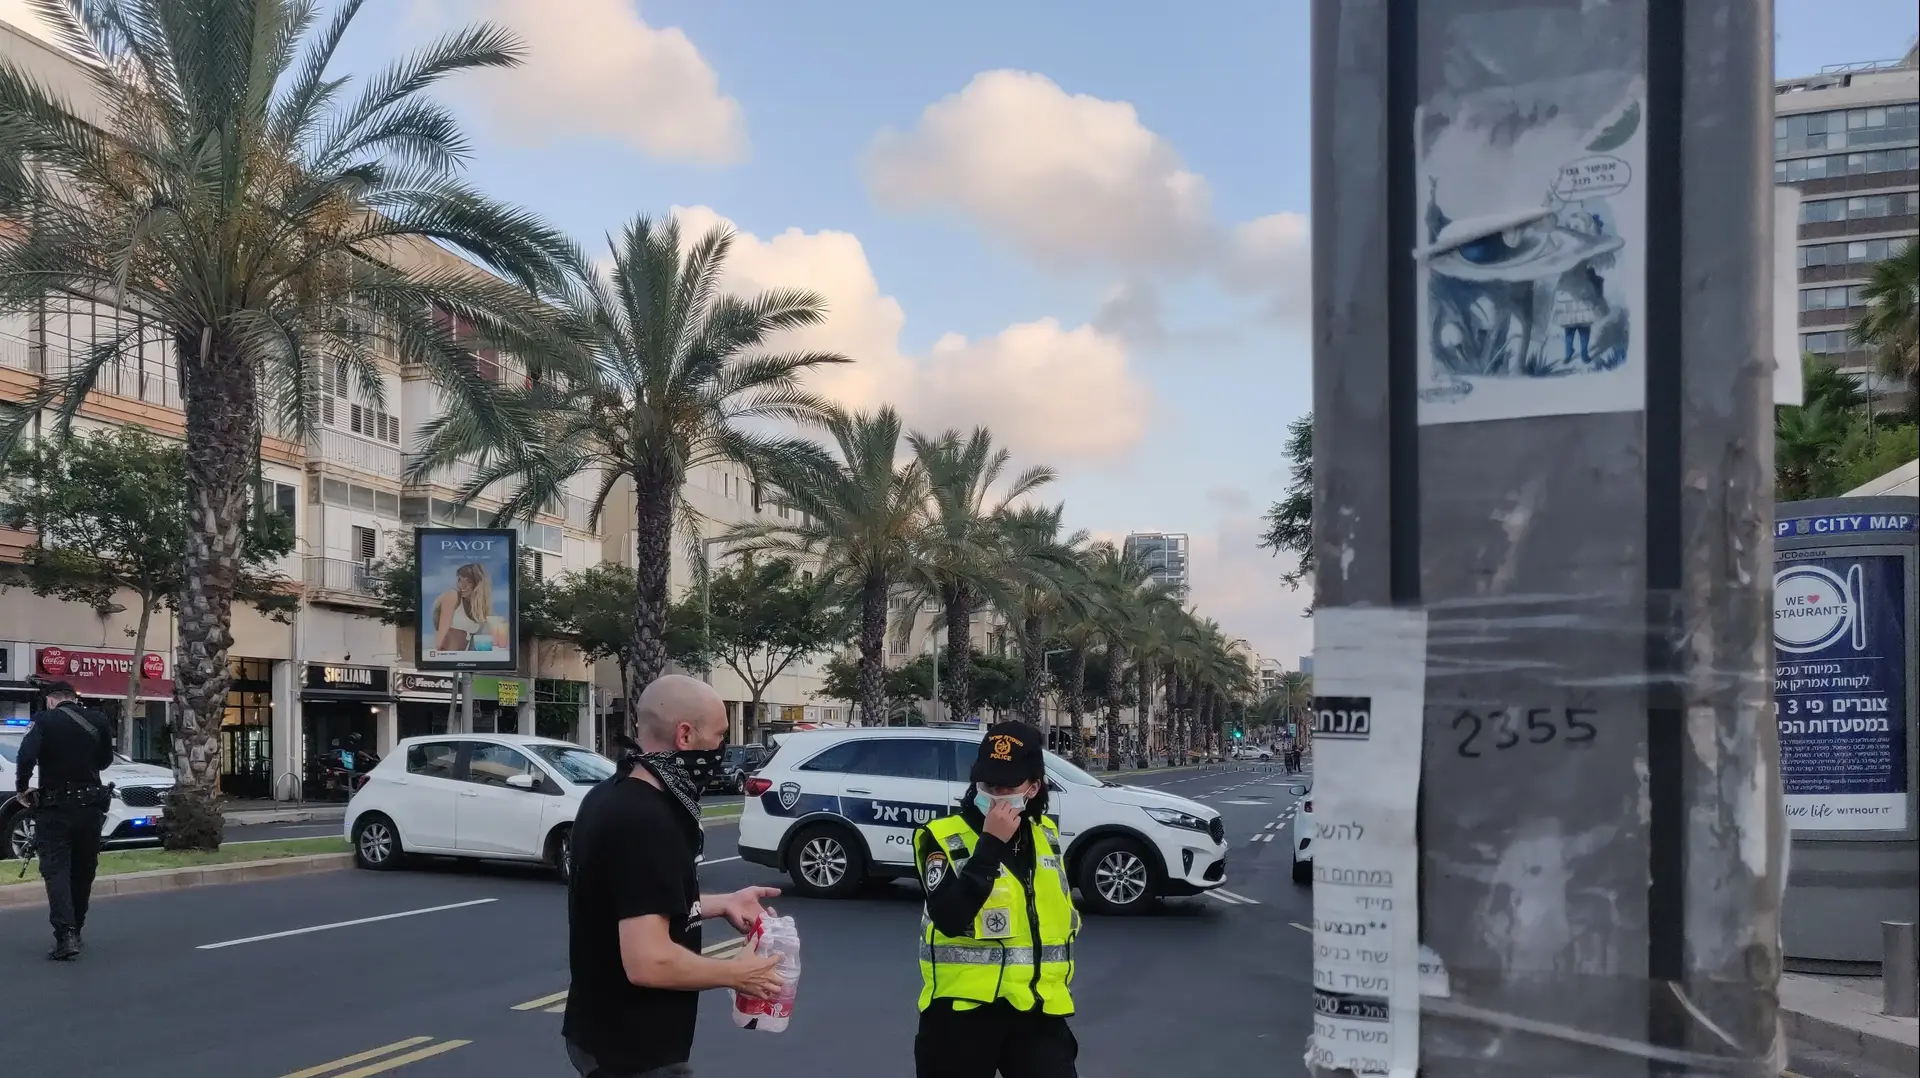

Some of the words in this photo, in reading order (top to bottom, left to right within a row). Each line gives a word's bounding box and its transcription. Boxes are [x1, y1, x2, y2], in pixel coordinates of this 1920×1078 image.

[1773, 522, 1790, 536] P
[1814, 518, 1862, 532] CITY
[1870, 516, 1908, 529] MAP
[441, 540, 495, 551] PAYOT
[1779, 551, 1827, 560] JCDecaux
[1785, 596, 1804, 606] WE
[324, 667, 372, 684] SICILIANA
[1801, 664, 1841, 675] במיוחד
[1790, 679, 1829, 691] אמריקן
[1831, 675, 1870, 688] לקוחות
[1787, 699, 1799, 714] 3
[1806, 701, 1824, 713] פי
[1832, 698, 1888, 712] צוברים
[1452, 707, 1598, 758] 2355
[1808, 718, 1889, 734] במסעדות
[990, 753, 1012, 761] POLICE
[871, 800, 937, 824] ישראל
[1785, 804, 1808, 816] live
[1811, 803, 1833, 819] life
[1837, 807, 1879, 815] WITHOUT
[1332, 868, 1393, 884] במתחם
[1341, 974, 1389, 991] משרד
[1341, 1028, 1388, 1044] משרד
